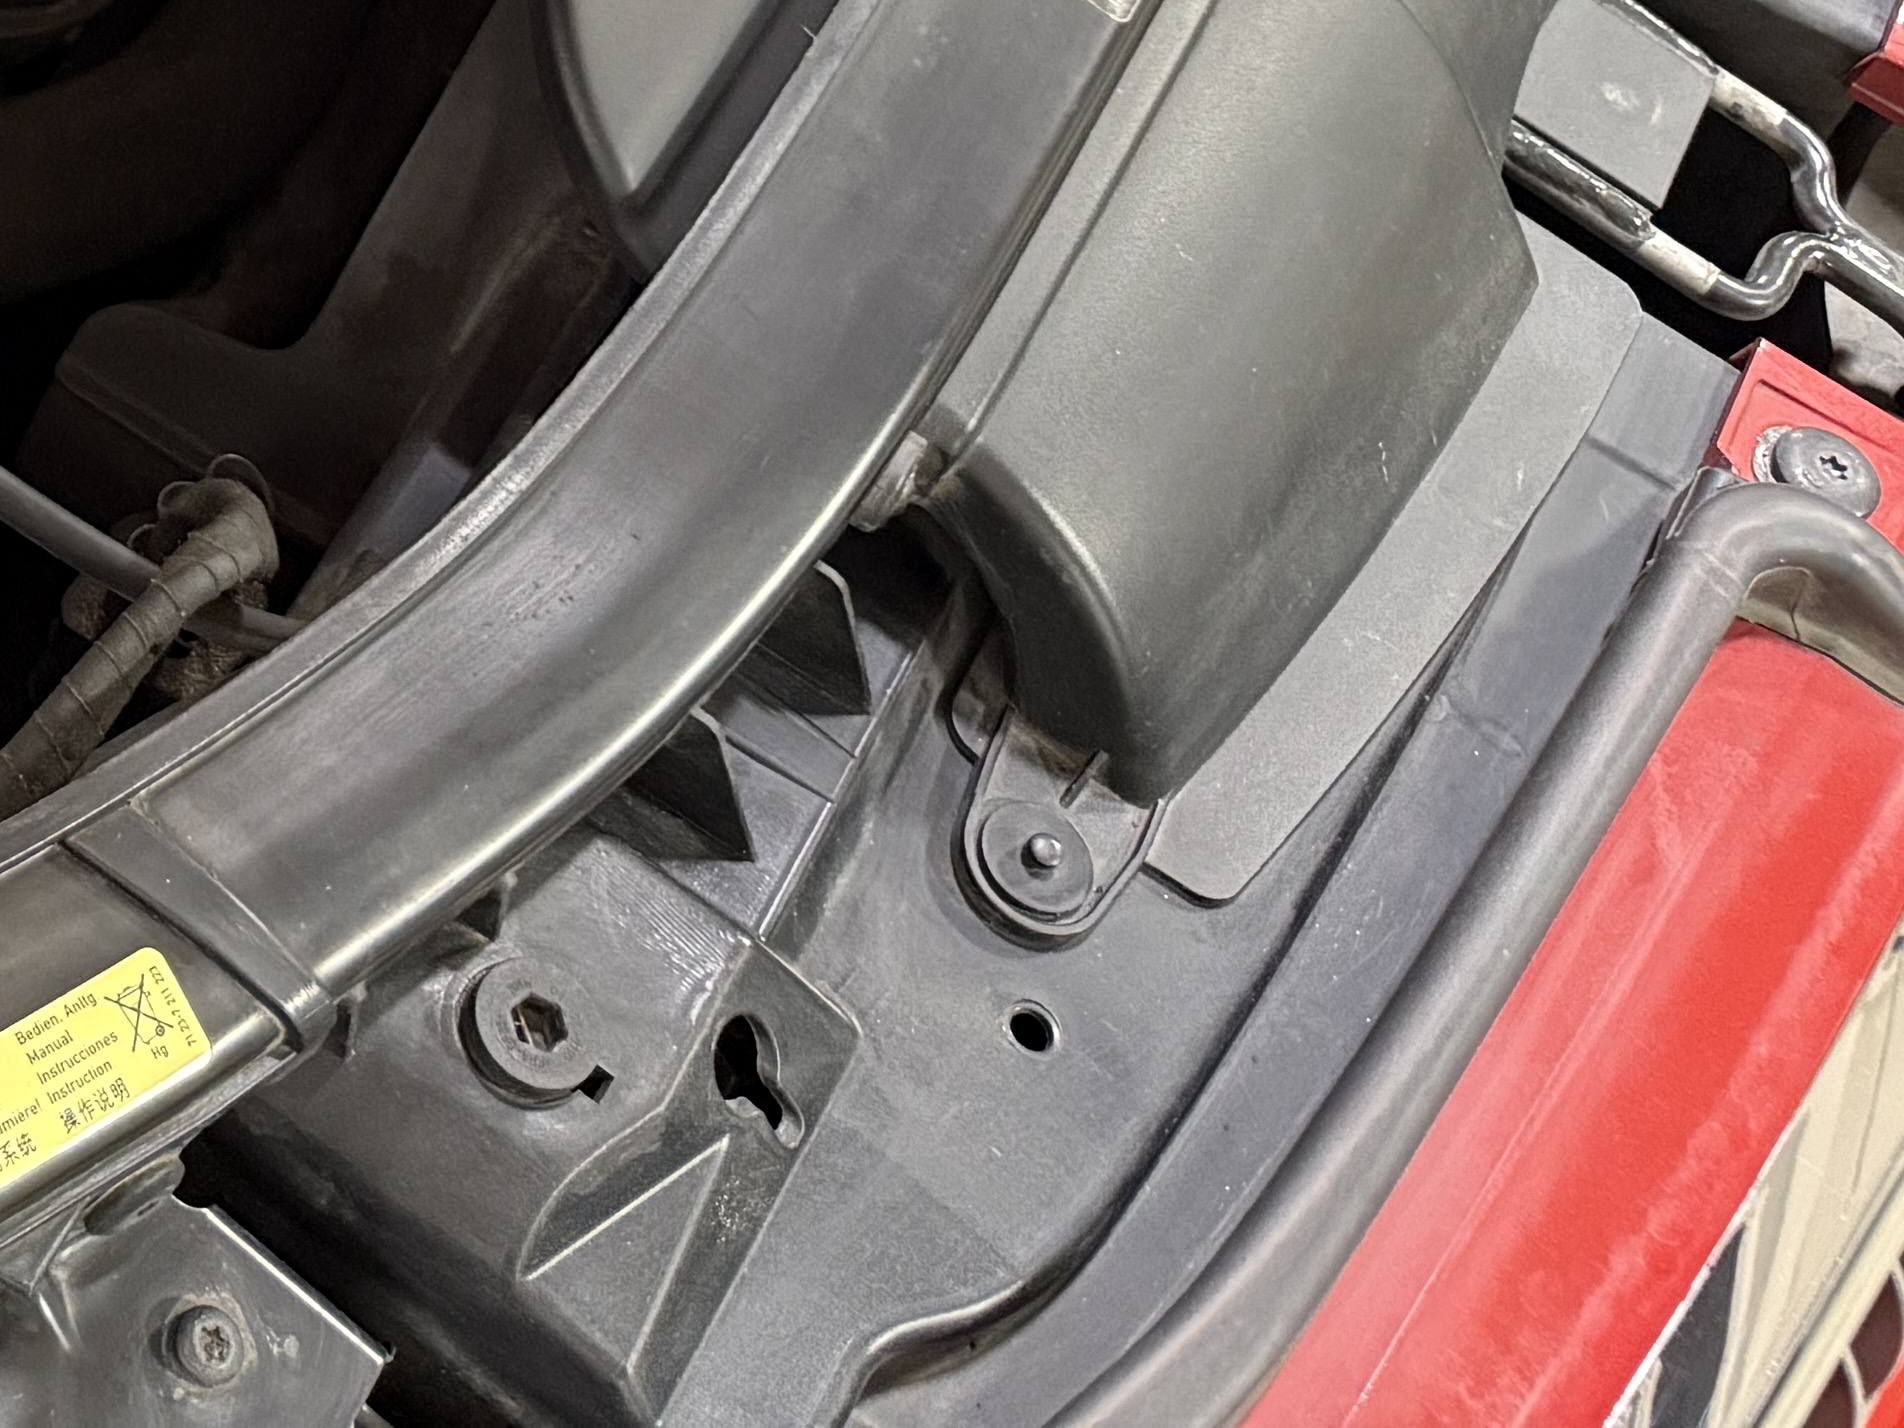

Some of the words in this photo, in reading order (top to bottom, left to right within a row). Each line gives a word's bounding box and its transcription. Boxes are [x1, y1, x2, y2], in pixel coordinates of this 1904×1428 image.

[148, 965, 164, 984] 223
[160, 987, 176, 1005] 211
[14, 1015, 62, 1045] Bedien.
[25, 1029, 73, 1064] Manual
[36, 1031, 118, 1084] Instrucciones
[150, 1045, 168, 1059] Hg
[46, 1061, 112, 1104] Instruction
[59, 1077, 130, 1134] 操作说明
